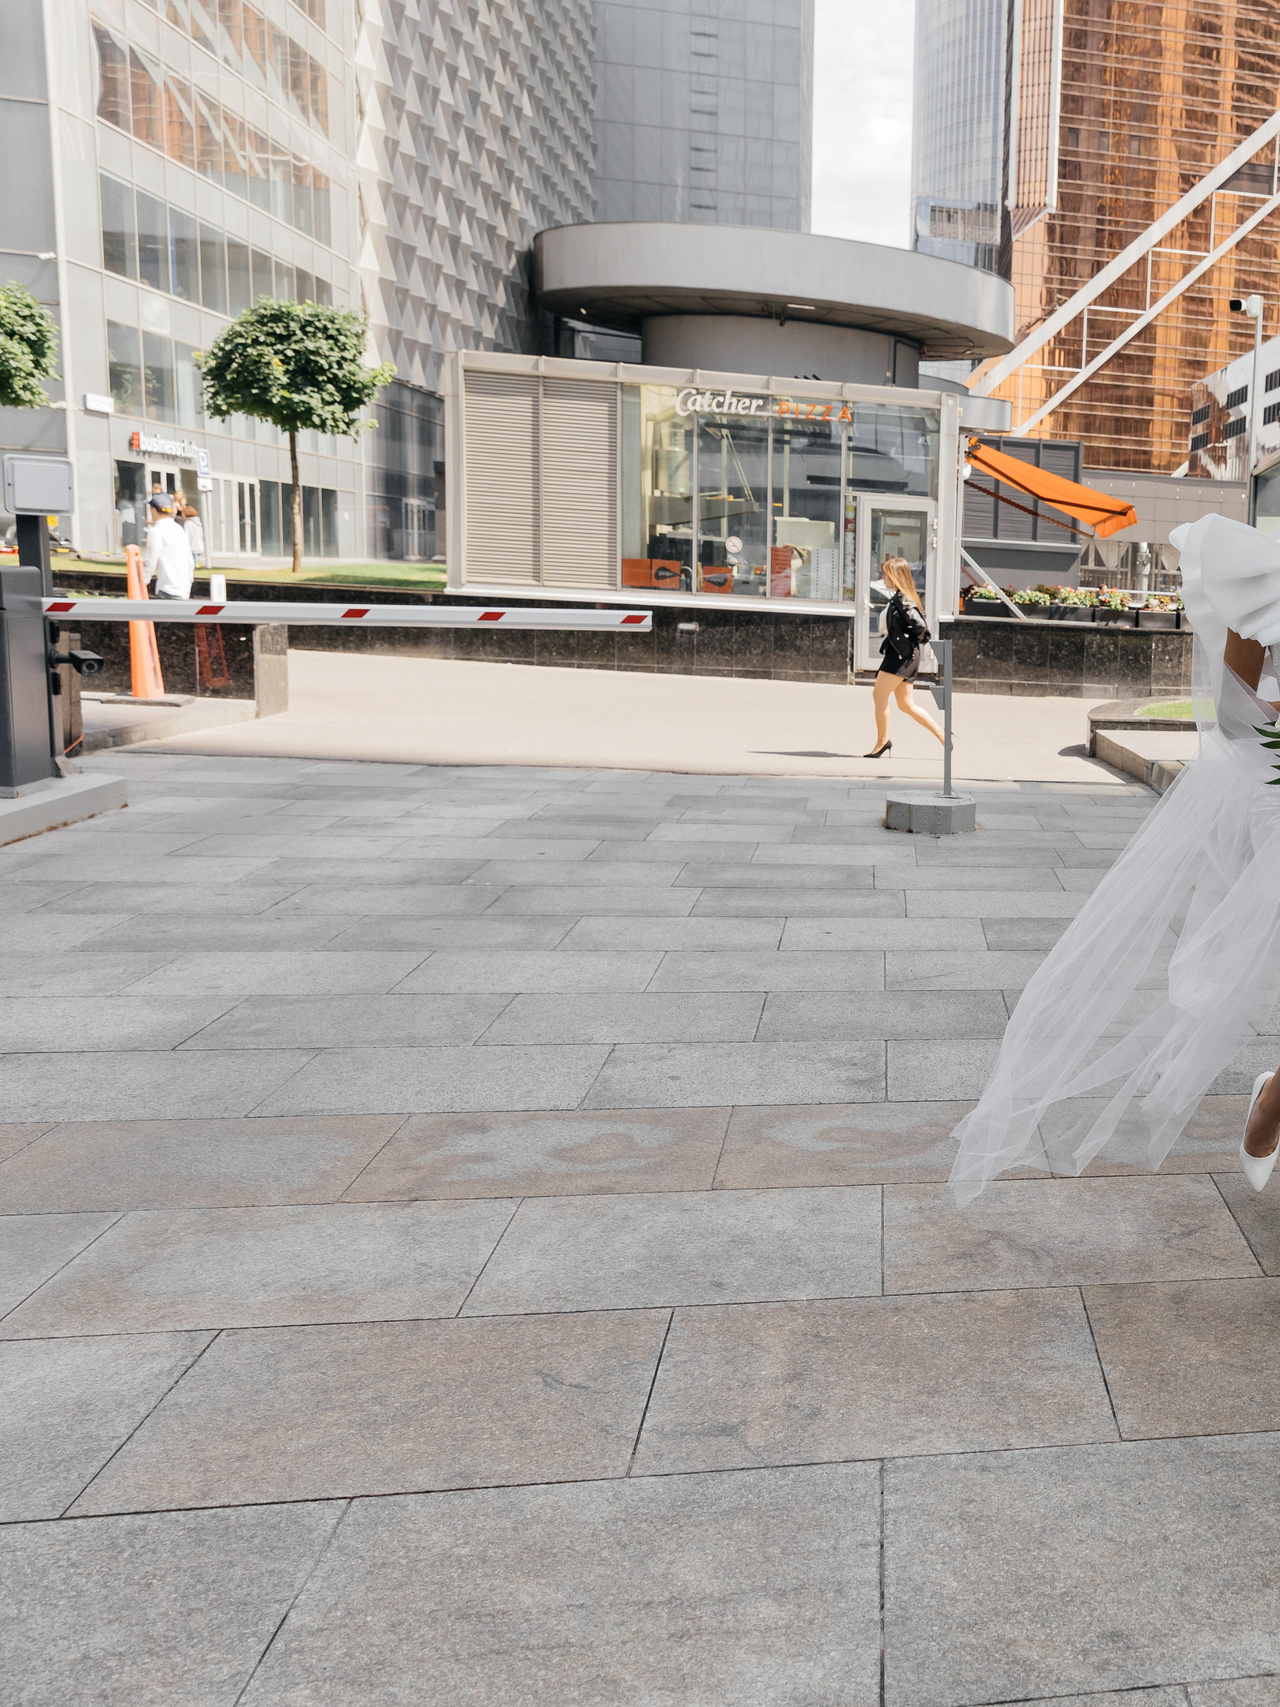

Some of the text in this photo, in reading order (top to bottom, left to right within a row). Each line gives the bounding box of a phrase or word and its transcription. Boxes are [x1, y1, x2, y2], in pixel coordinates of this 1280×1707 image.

[675, 388, 852, 422] Catcher PIZZA
[199, 452, 210, 474] P
